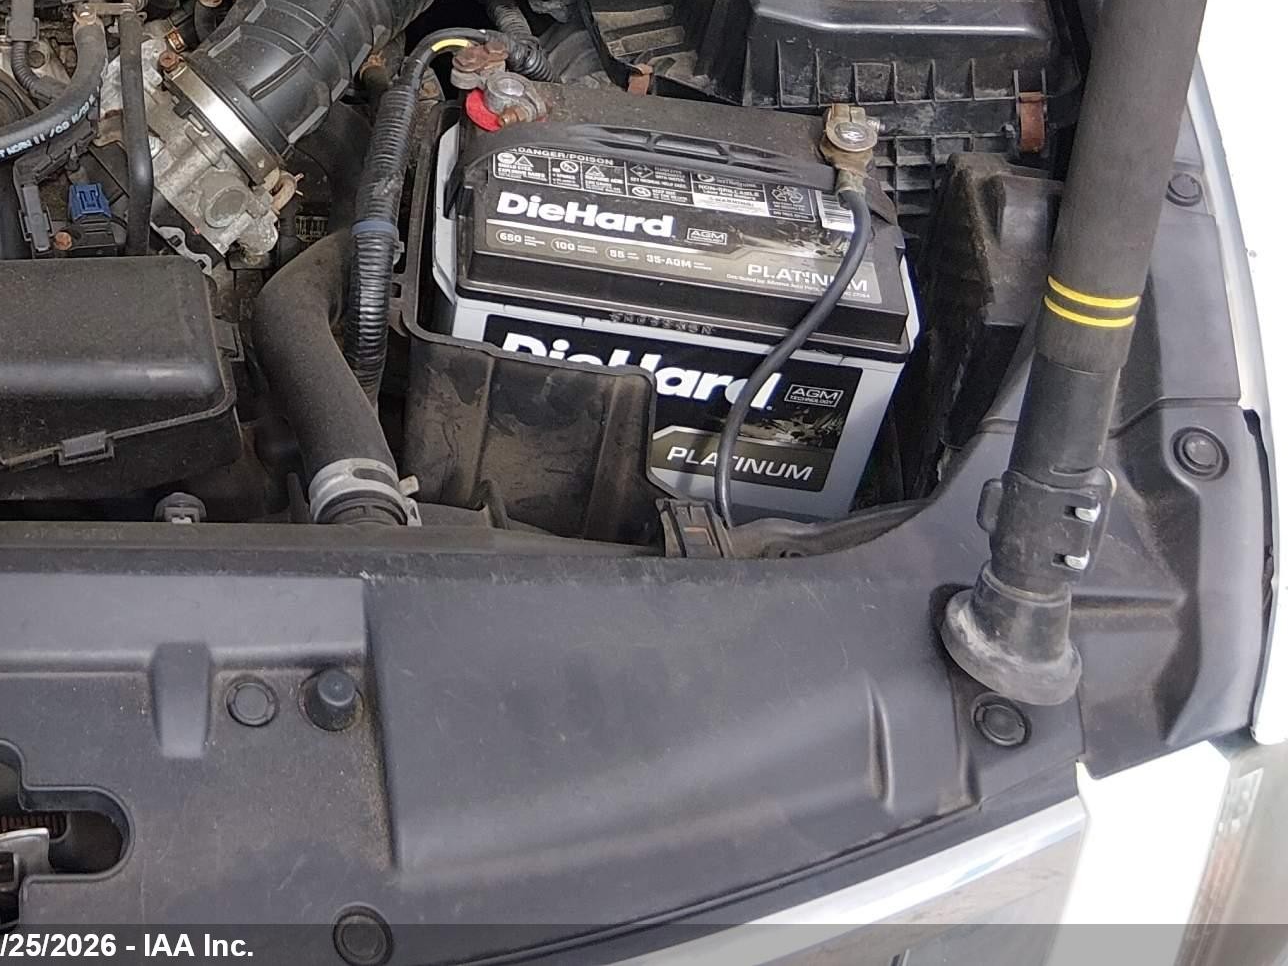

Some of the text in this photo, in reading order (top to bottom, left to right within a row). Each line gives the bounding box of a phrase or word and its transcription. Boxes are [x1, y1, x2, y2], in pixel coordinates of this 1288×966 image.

[496, 191, 674, 238] DieHard
[690, 230, 725, 240] AGM
[792, 387, 839, 400] AGM
[667, 445, 814, 482] PLAINUM
